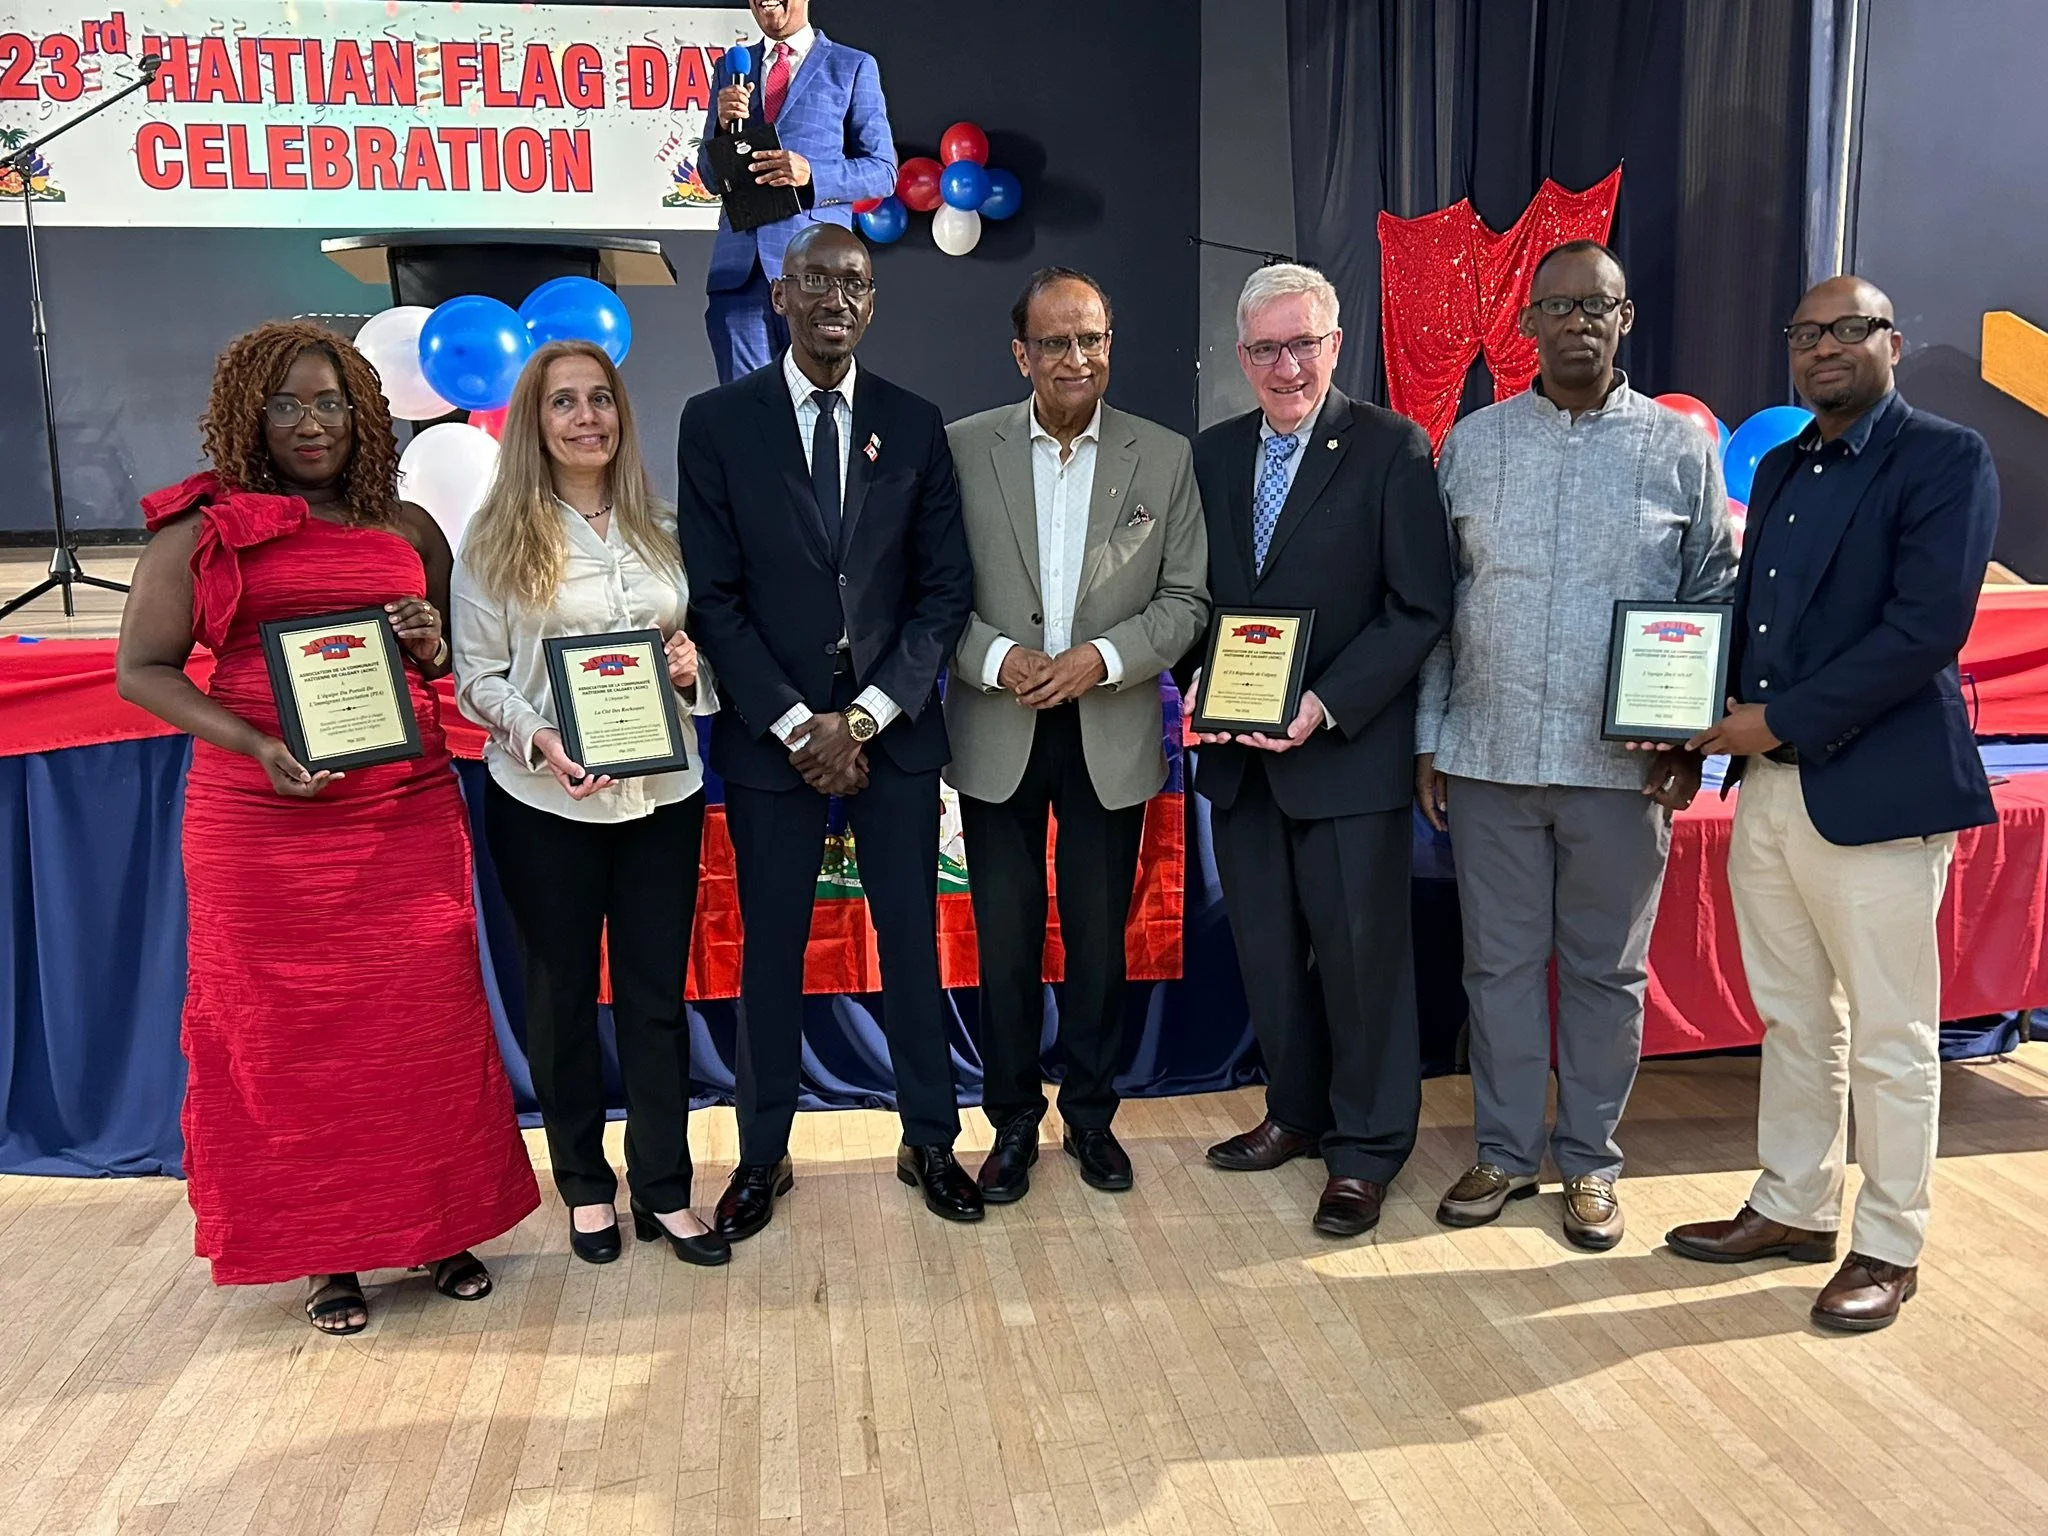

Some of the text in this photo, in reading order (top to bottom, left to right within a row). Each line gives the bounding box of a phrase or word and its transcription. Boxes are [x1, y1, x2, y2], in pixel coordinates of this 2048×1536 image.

[142, 35, 416, 108] HAITIAN
[440, 42, 605, 110] FLAG
[136, 121, 594, 193] CELEBRATION
